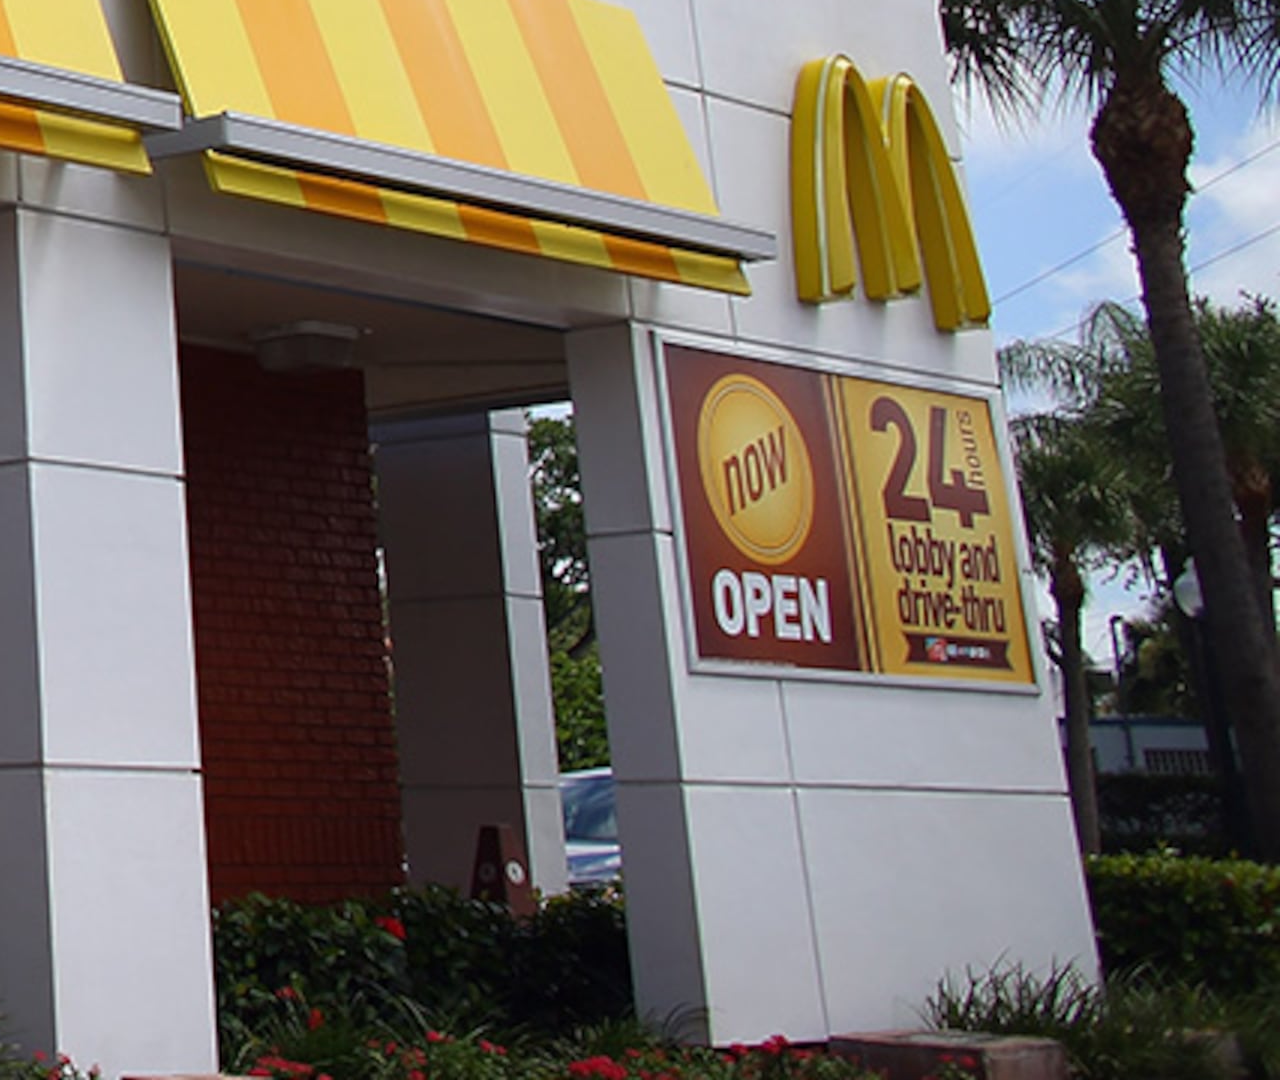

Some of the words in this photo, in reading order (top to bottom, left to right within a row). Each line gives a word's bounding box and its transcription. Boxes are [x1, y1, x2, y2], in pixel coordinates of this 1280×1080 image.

[721, 424, 789, 518] now
[868, 395, 992, 530] 24
[955, 409, 986, 491] hours
[959, 534, 1001, 583] and
[711, 567, 832, 644] OPEN
[897, 577, 1007, 633] drive-thru
